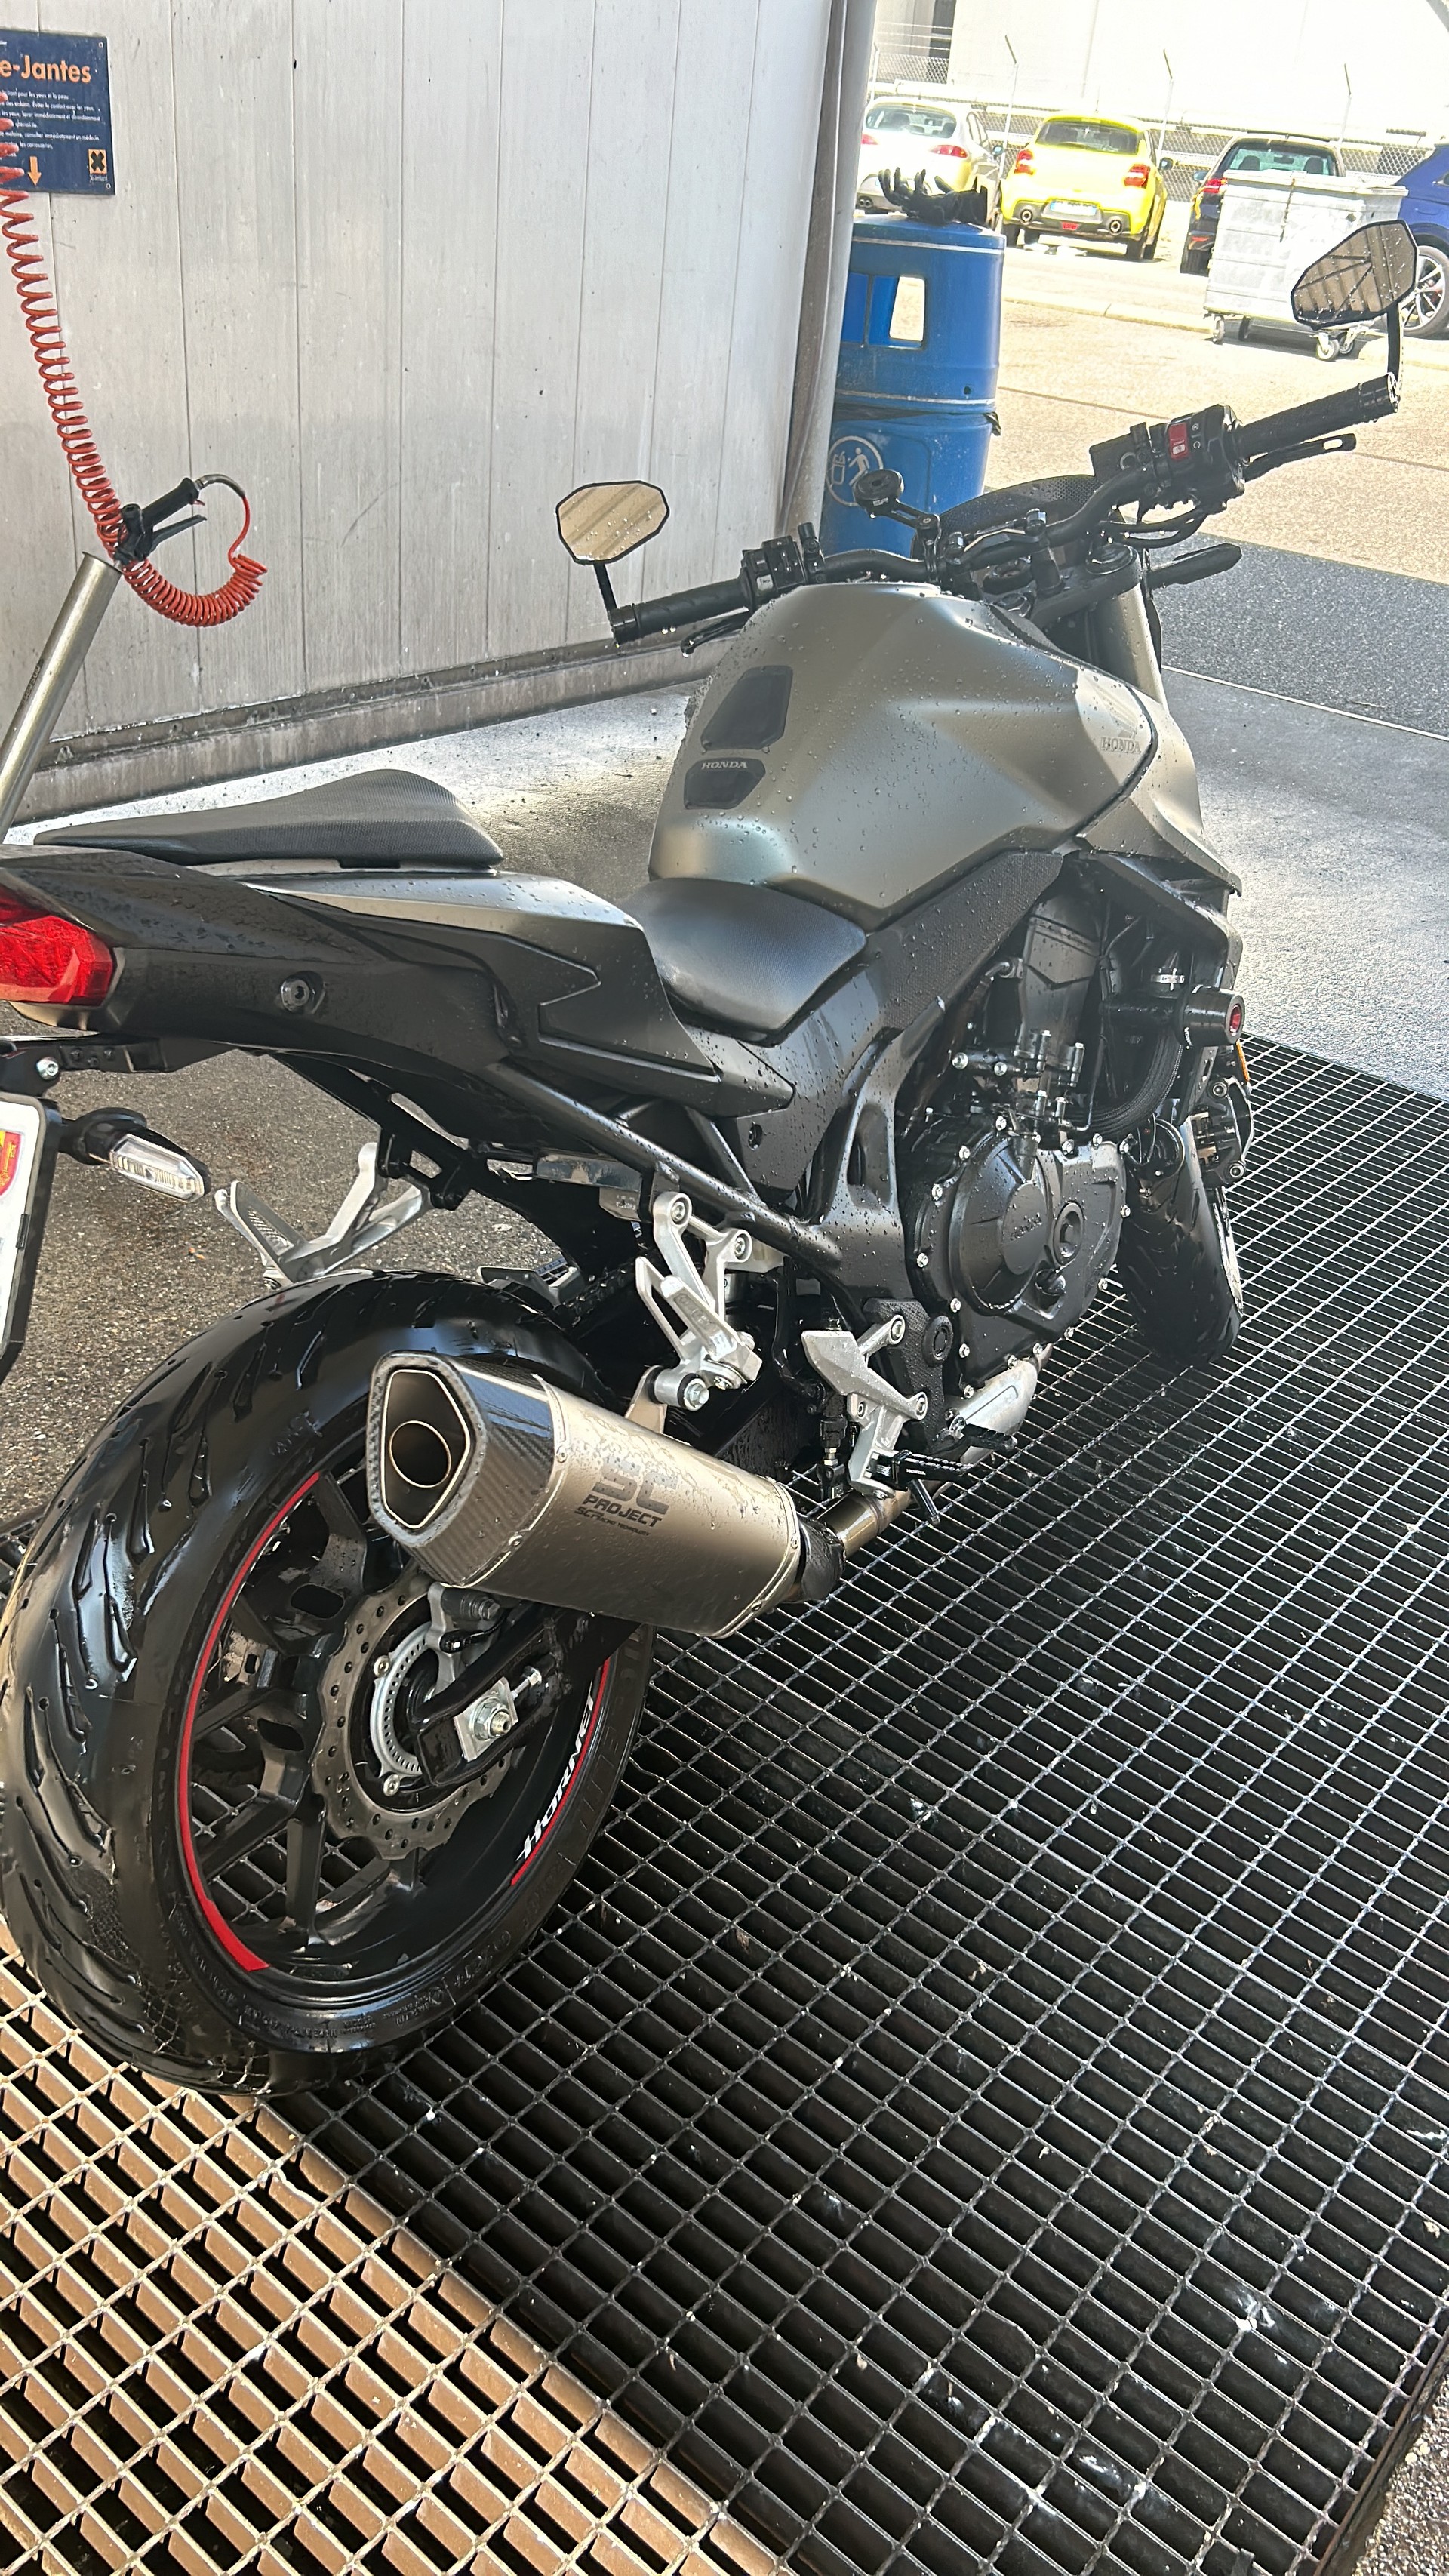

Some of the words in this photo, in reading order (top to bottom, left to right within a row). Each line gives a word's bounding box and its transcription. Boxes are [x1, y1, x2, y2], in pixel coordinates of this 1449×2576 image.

[1102, 737, 1142, 754] HONDA
[701, 761, 749, 769] HONDA
[592, 1456, 678, 1516] SC
[582, 1494, 663, 1528] PROJECT
[515, 1680, 594, 1863] HORNET
